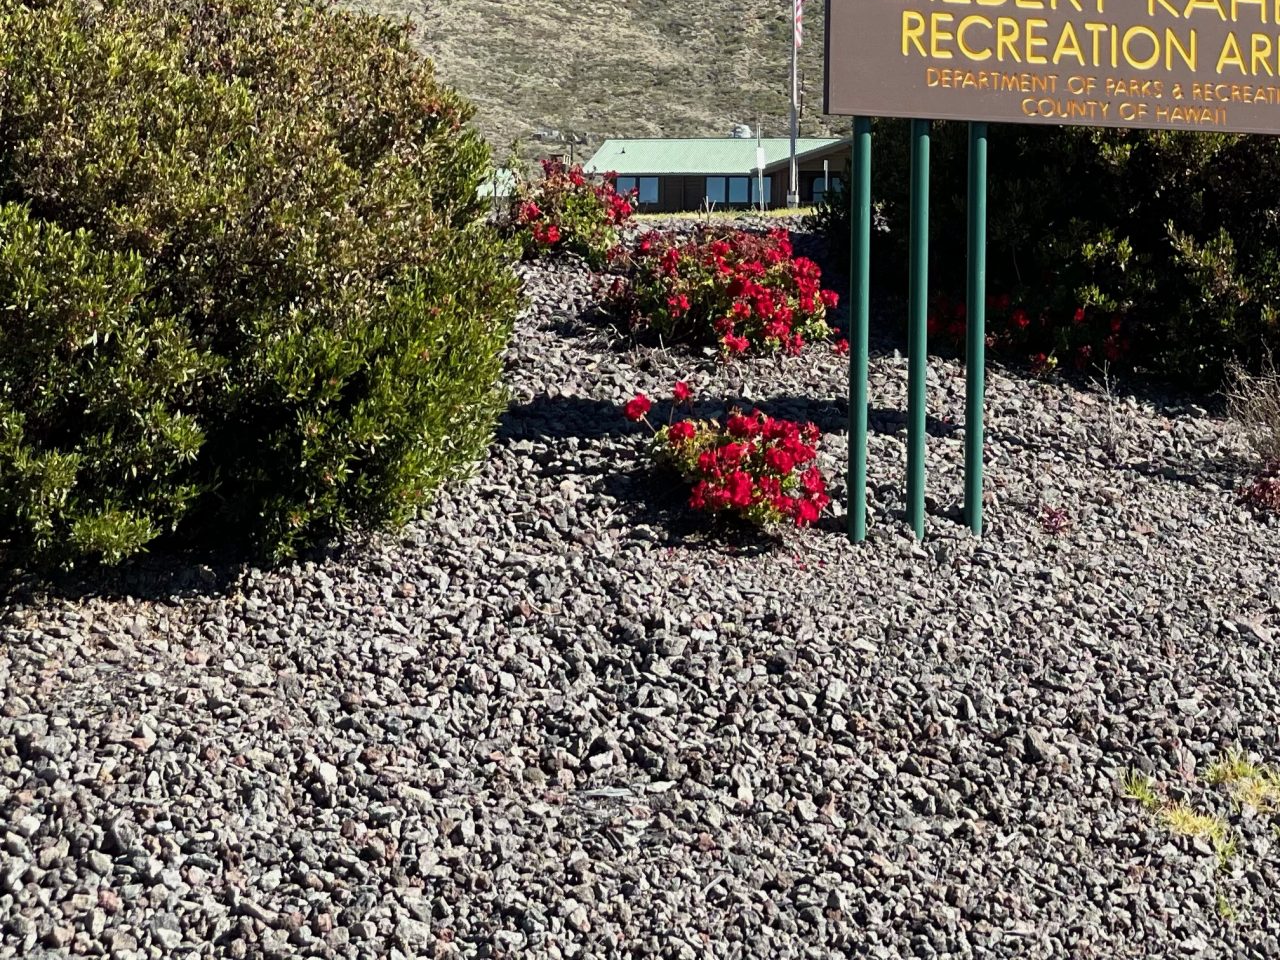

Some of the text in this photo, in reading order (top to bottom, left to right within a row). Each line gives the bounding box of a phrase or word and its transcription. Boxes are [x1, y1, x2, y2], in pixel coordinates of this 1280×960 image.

[902, 10, 1197, 73] RECREATION
[926, 67, 1058, 93] DEPARTMENT
[1067, 76, 1097, 95] OF
[1105, 77, 1164, 99] PARKS
[1171, 82, 1185, 100] &
[1021, 96, 1228, 126] COUNTY OF HAWAII
